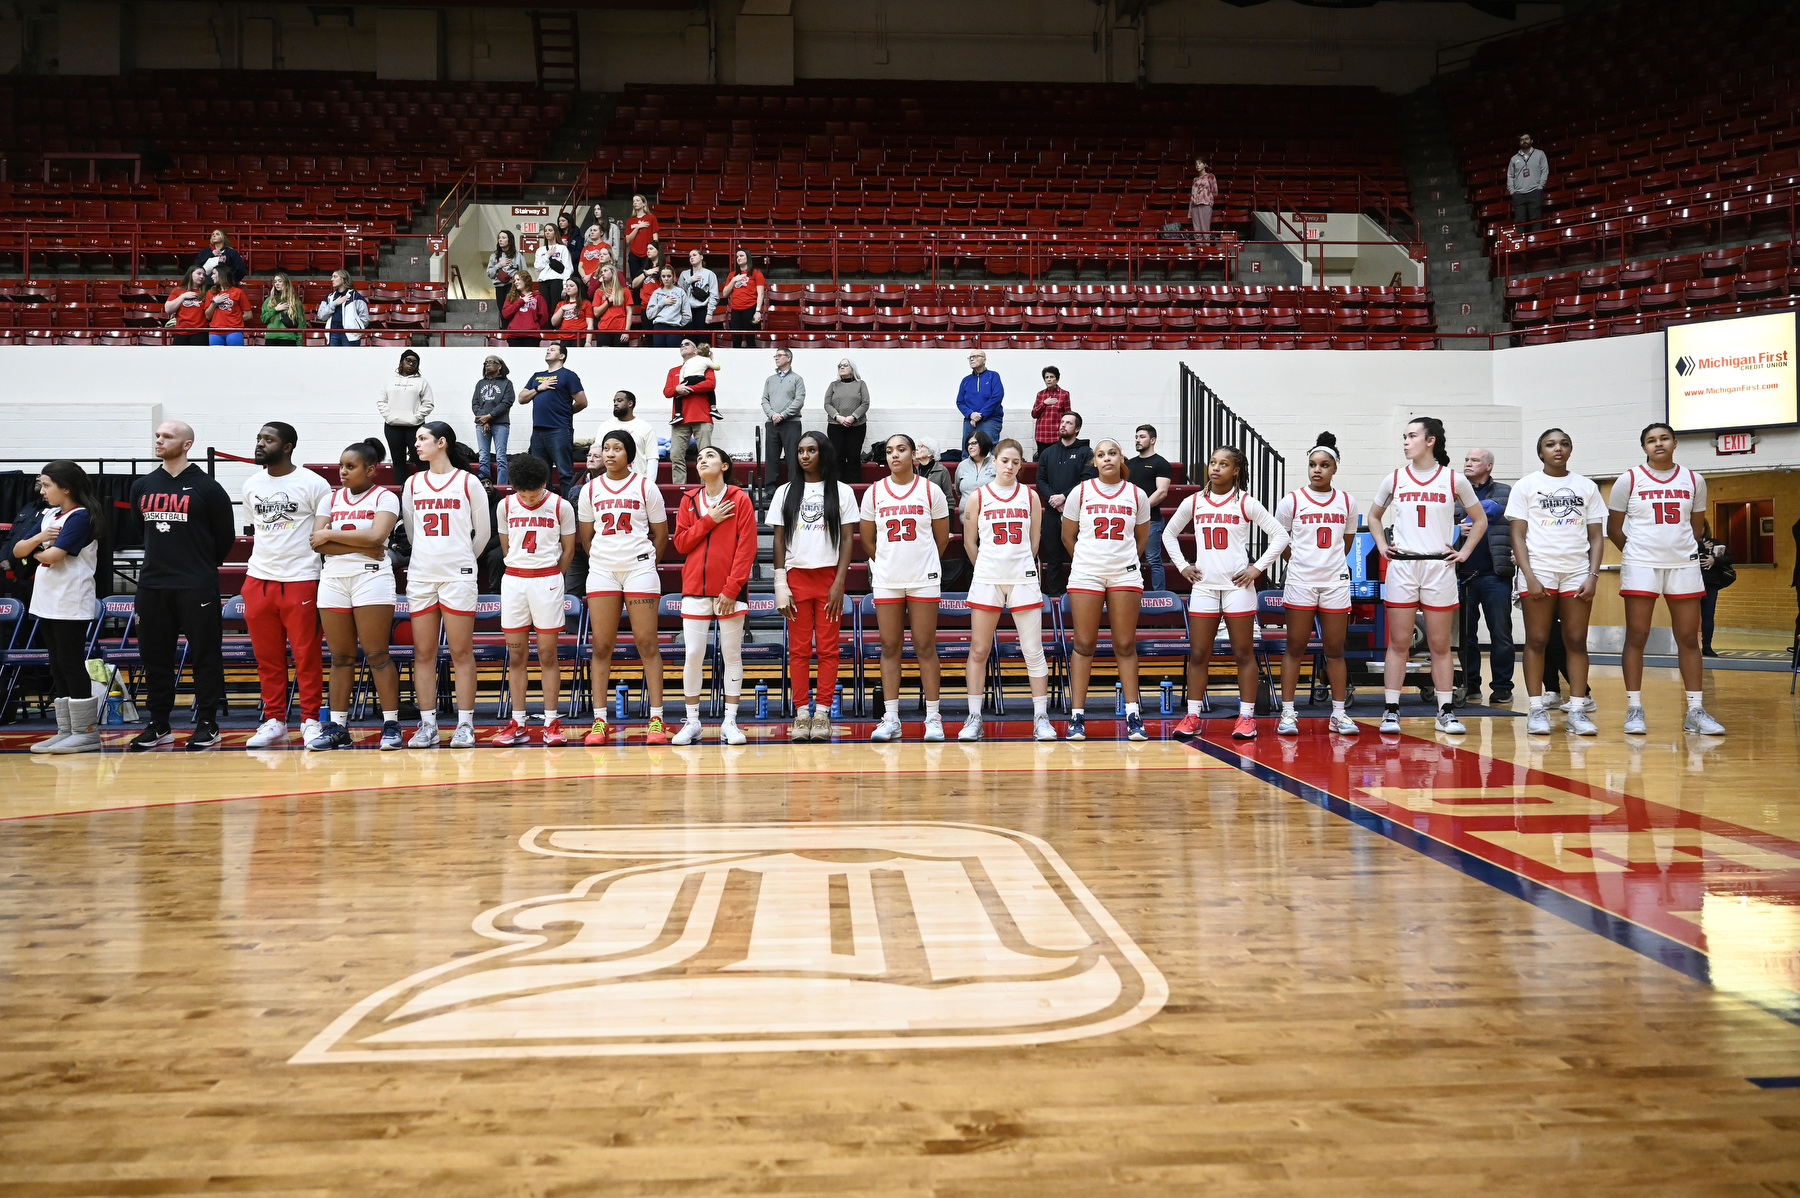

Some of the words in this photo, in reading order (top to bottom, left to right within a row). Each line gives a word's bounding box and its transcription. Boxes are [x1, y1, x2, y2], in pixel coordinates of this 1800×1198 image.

[1438, 208, 1446, 217] H
[524, 222, 537, 232] EXIT
[1252, 262, 1260, 273] E
[479, 302, 488, 312] D
[1462, 304, 1470, 315] D
[1698, 355, 1756, 369] Michigan
[1758, 350, 1788, 363] First
[1684, 383, 1779, 396] www.MichiganFirst.com
[1724, 434, 1747, 450] EXIT
[1399, 492, 1446, 504] TITANS
[1638, 489, 1691, 500] TITANS
[140, 493, 190, 513] UDM
[254, 501, 298, 515] TITANS
[413, 498, 461, 511] TITANS
[594, 498, 640, 512] TITANS
[1539, 495, 1585, 510] TITANS
[144, 511, 187, 522] BASKETBALL
[331, 510, 375, 522] TITANS
[879, 505, 924, 518] TITANS
[984, 508, 1028, 521] TITANS
[1086, 504, 1133, 516] TITANS
[1416, 505, 1426, 528] 1
[1652, 502, 1680, 524] 15
[423, 513, 450, 536] 21
[508, 517, 555, 529] TITANS
[602, 512, 632, 535] 24
[1195, 513, 1240, 525] TITANS
[1300, 513, 1346, 525] TITANS
[272, 522, 297, 530] PRIDE
[886, 518, 917, 542] 23
[1094, 517, 1126, 540] 22
[992, 522, 1022, 545] 55
[1202, 527, 1228, 550] 10
[1316, 526, 1332, 549] 0
[522, 531, 537, 553] 4
